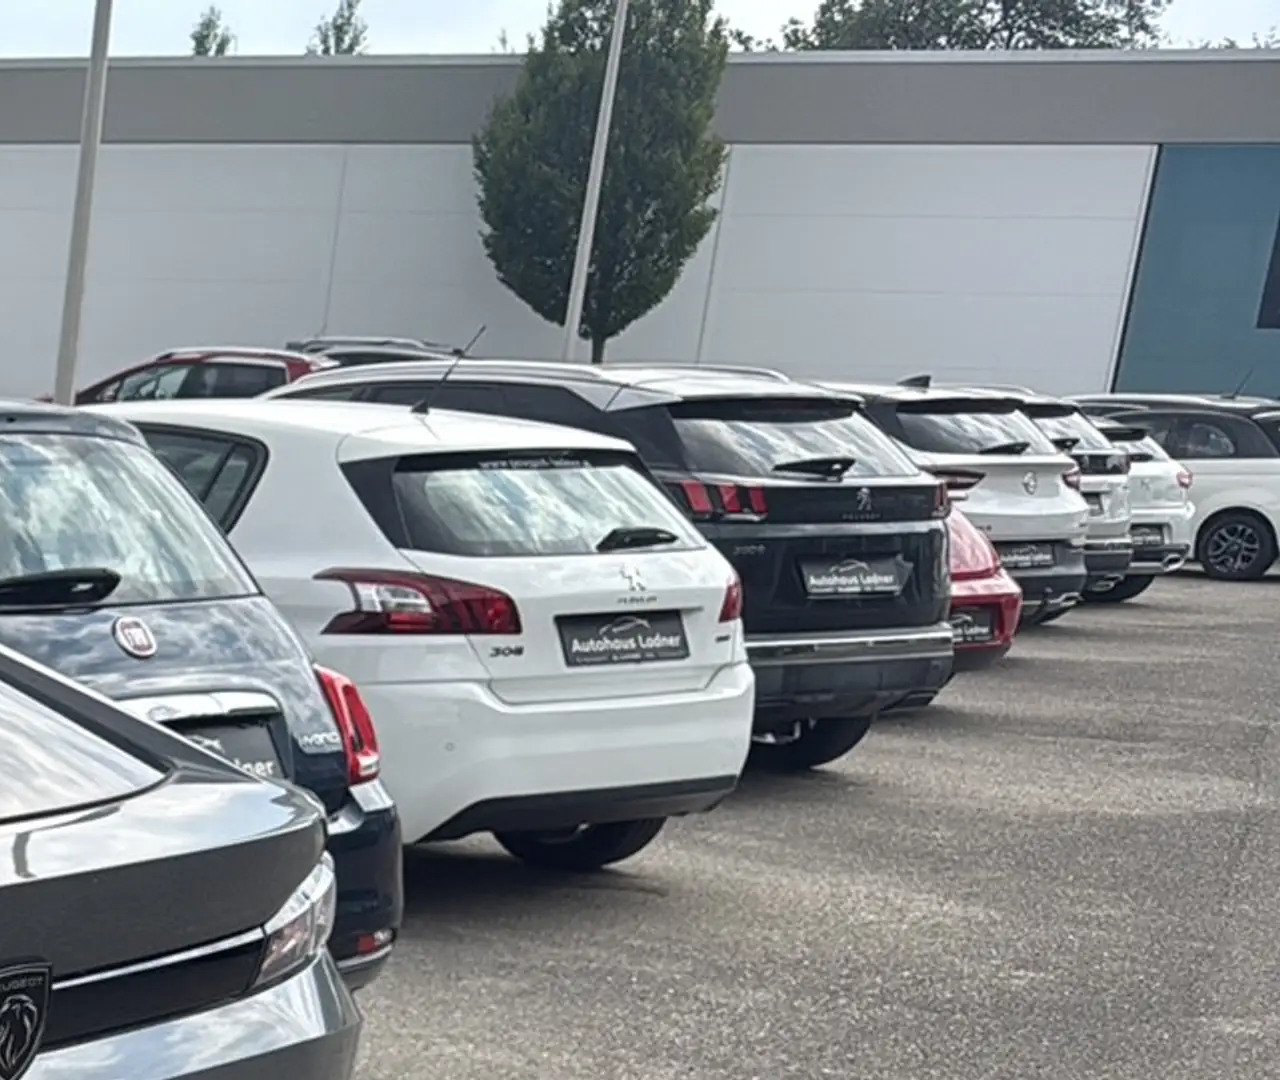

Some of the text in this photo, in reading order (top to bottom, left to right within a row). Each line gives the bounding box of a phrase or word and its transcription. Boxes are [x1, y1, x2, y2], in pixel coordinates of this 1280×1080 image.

[571, 633, 681, 653] Autohaus Ladner
[489, 645, 524, 658] 308
